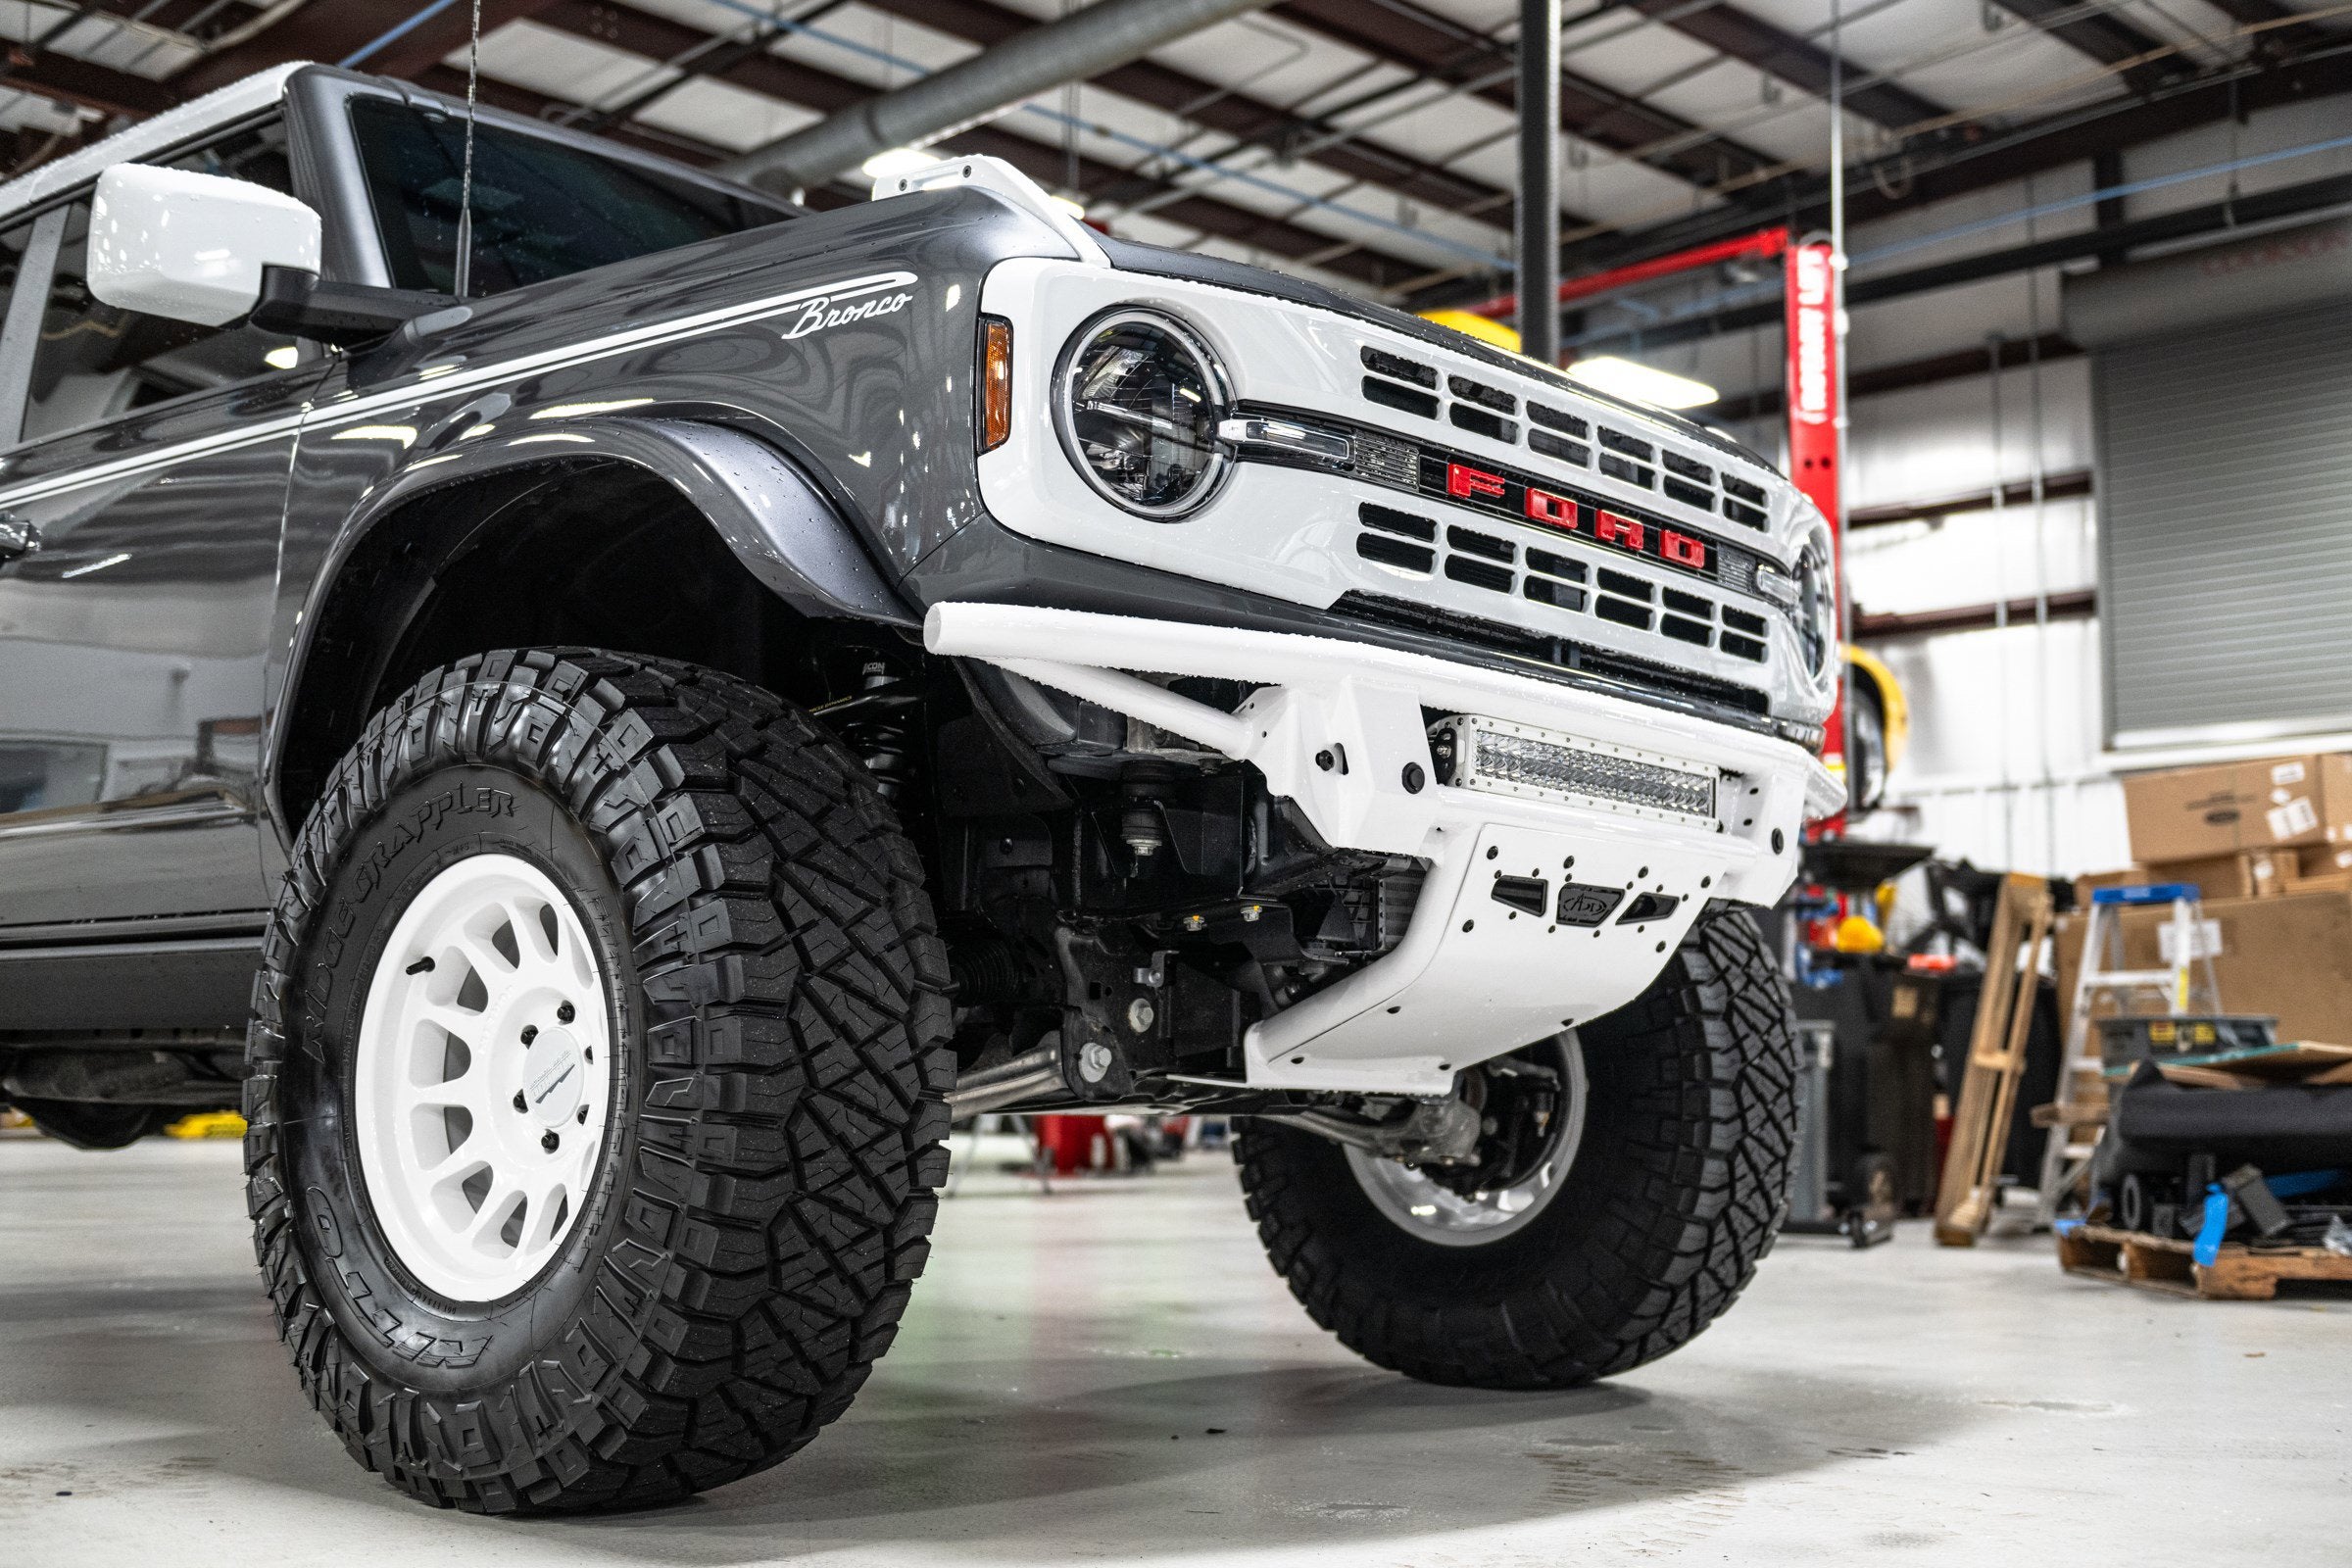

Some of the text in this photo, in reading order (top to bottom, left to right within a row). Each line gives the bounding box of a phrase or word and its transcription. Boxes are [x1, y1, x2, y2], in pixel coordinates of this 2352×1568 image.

[781, 293, 913, 339] Bronco
[1447, 463, 1704, 568] FORD
[350, 781, 514, 904] GRAPPLER
[305, 1186, 494, 1369] NITTO
